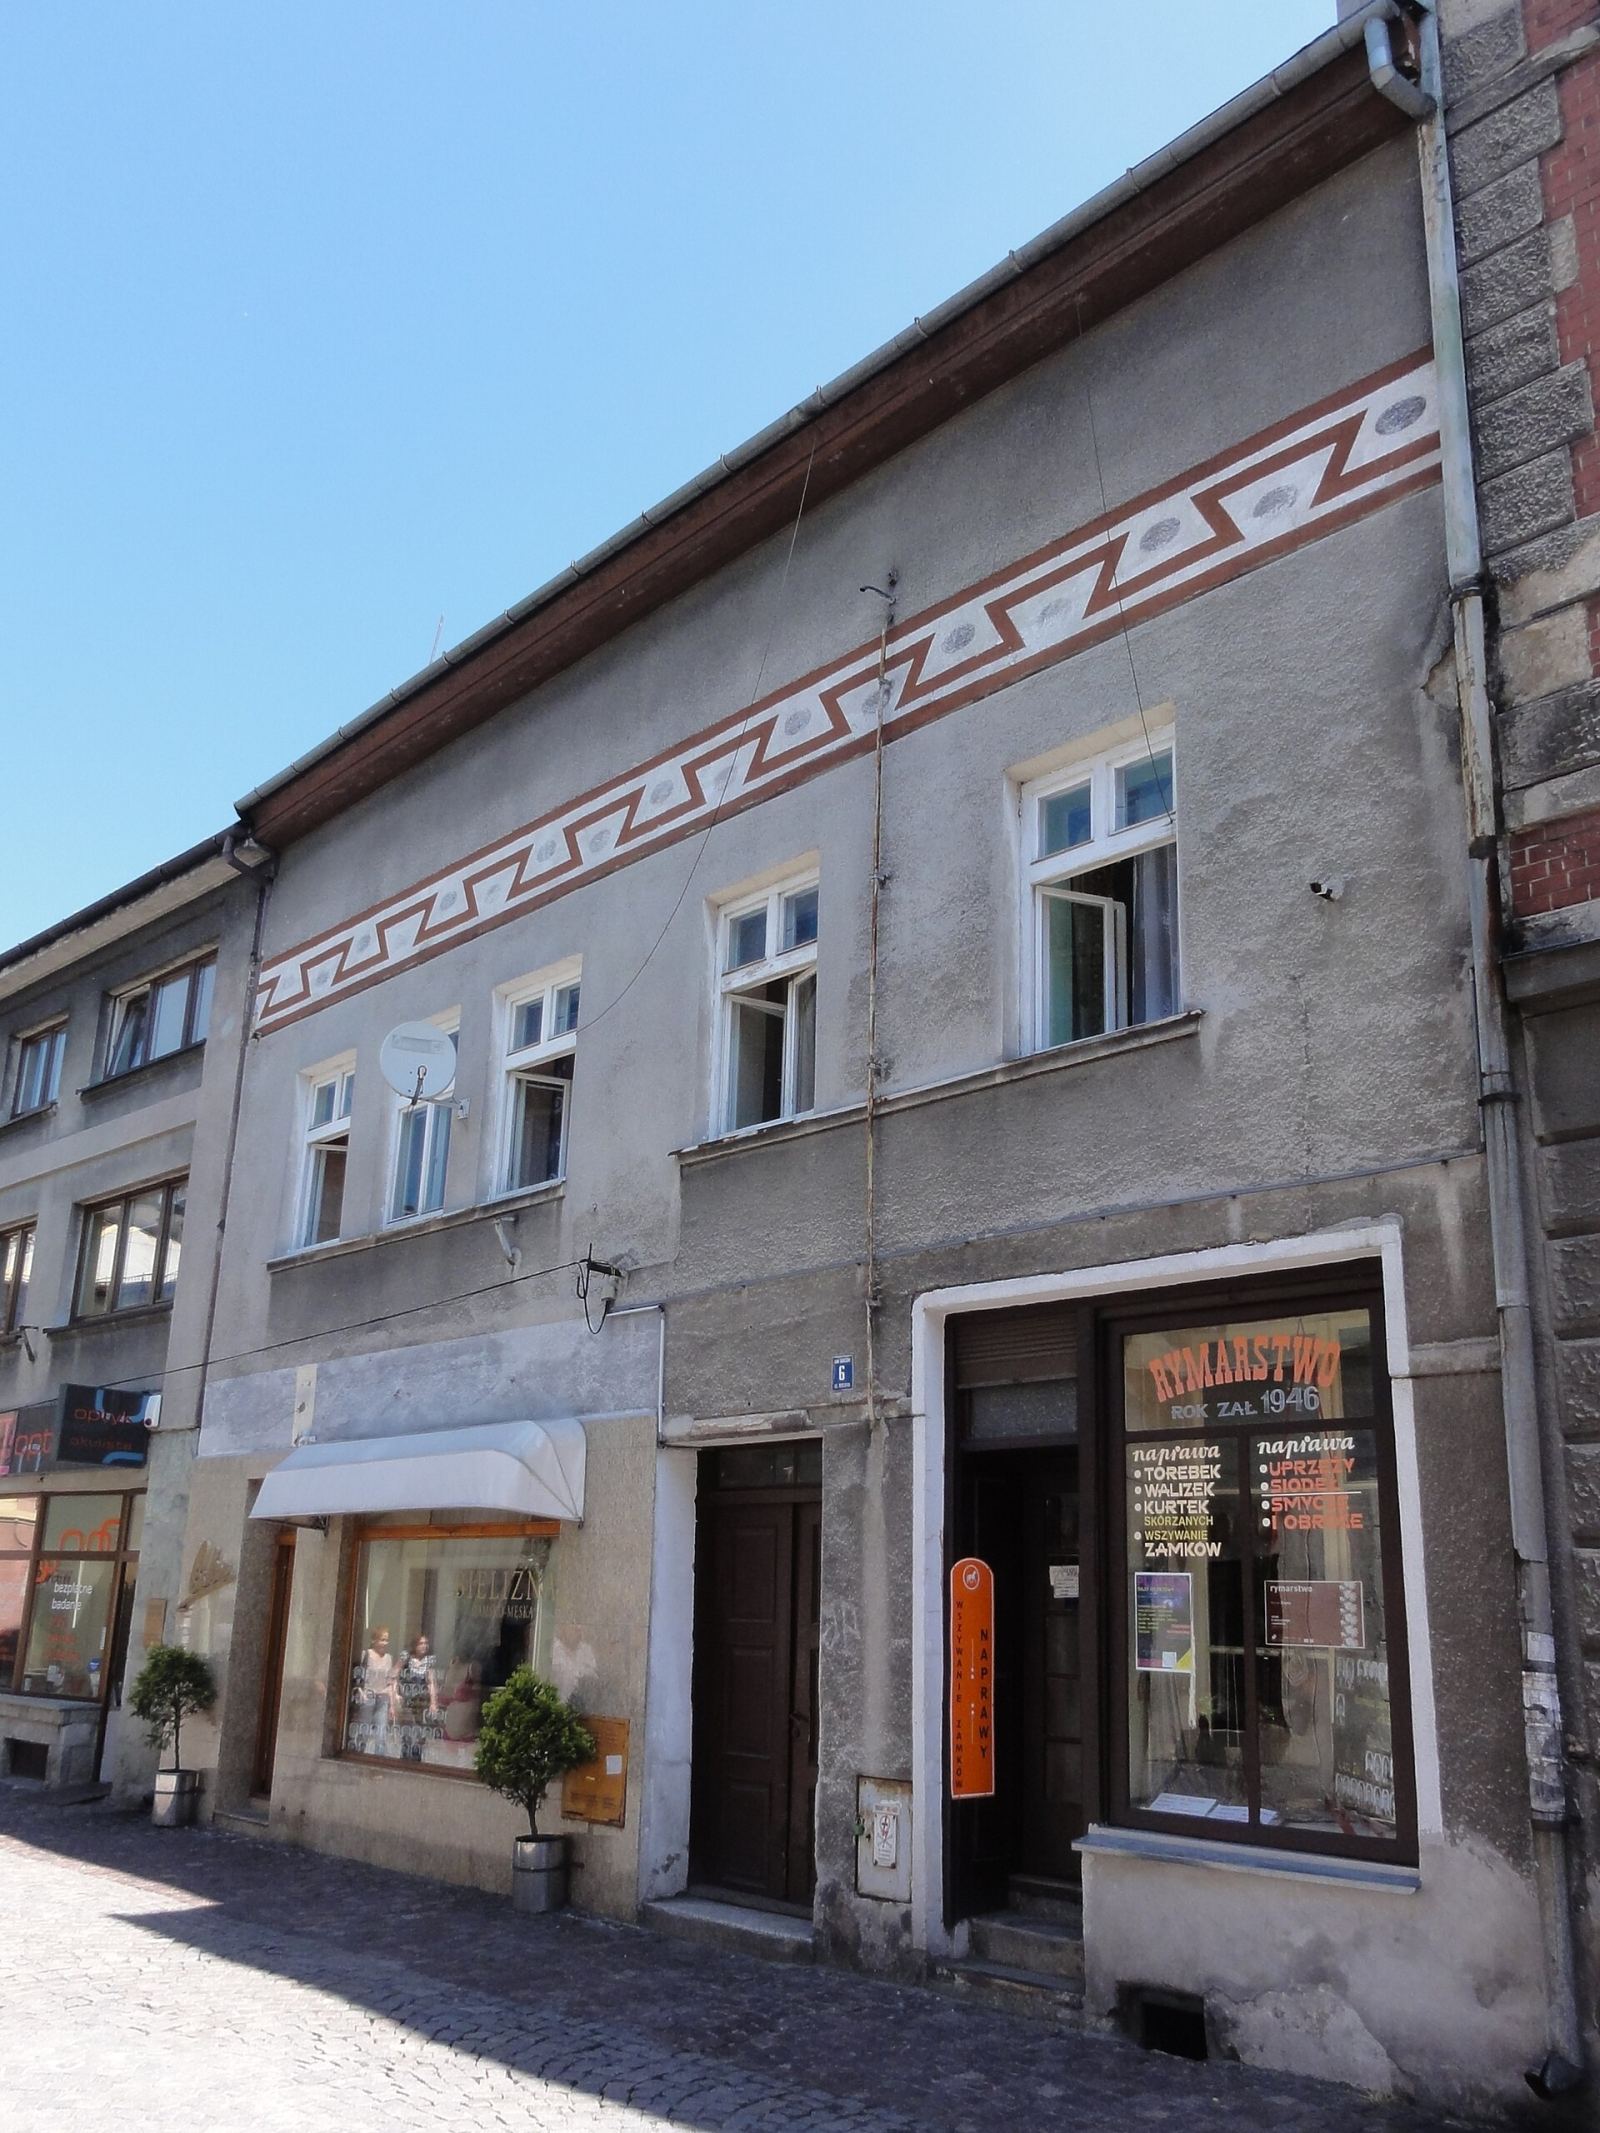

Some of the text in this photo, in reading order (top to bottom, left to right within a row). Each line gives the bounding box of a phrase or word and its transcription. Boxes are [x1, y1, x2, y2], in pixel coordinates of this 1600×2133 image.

[838, 1364, 846, 1381] 6
[1149, 1335, 1341, 1403] RYMARSTWO
[1171, 1403, 1208, 1420] ROK
[1261, 1386, 1320, 1414] 1946
[1132, 1445, 1221, 1466] naprawa
[1257, 1436, 1355, 1459] naprawa
[1144, 1464, 1221, 1480] TOREBEK
[1144, 1482, 1215, 1498] WALIZEK
[1144, 1499, 1210, 1514] KURTEK
[1144, 1514, 1213, 1526] SKÓRZANYCH
[1144, 1530, 1208, 1540] WSZYWANIE
[1270, 1585, 1313, 1594] rymarstwo
[955, 1600, 964, 1788] WSZYWANIE ZAMKÓW
[979, 1628, 989, 1759] NAPRAWY
